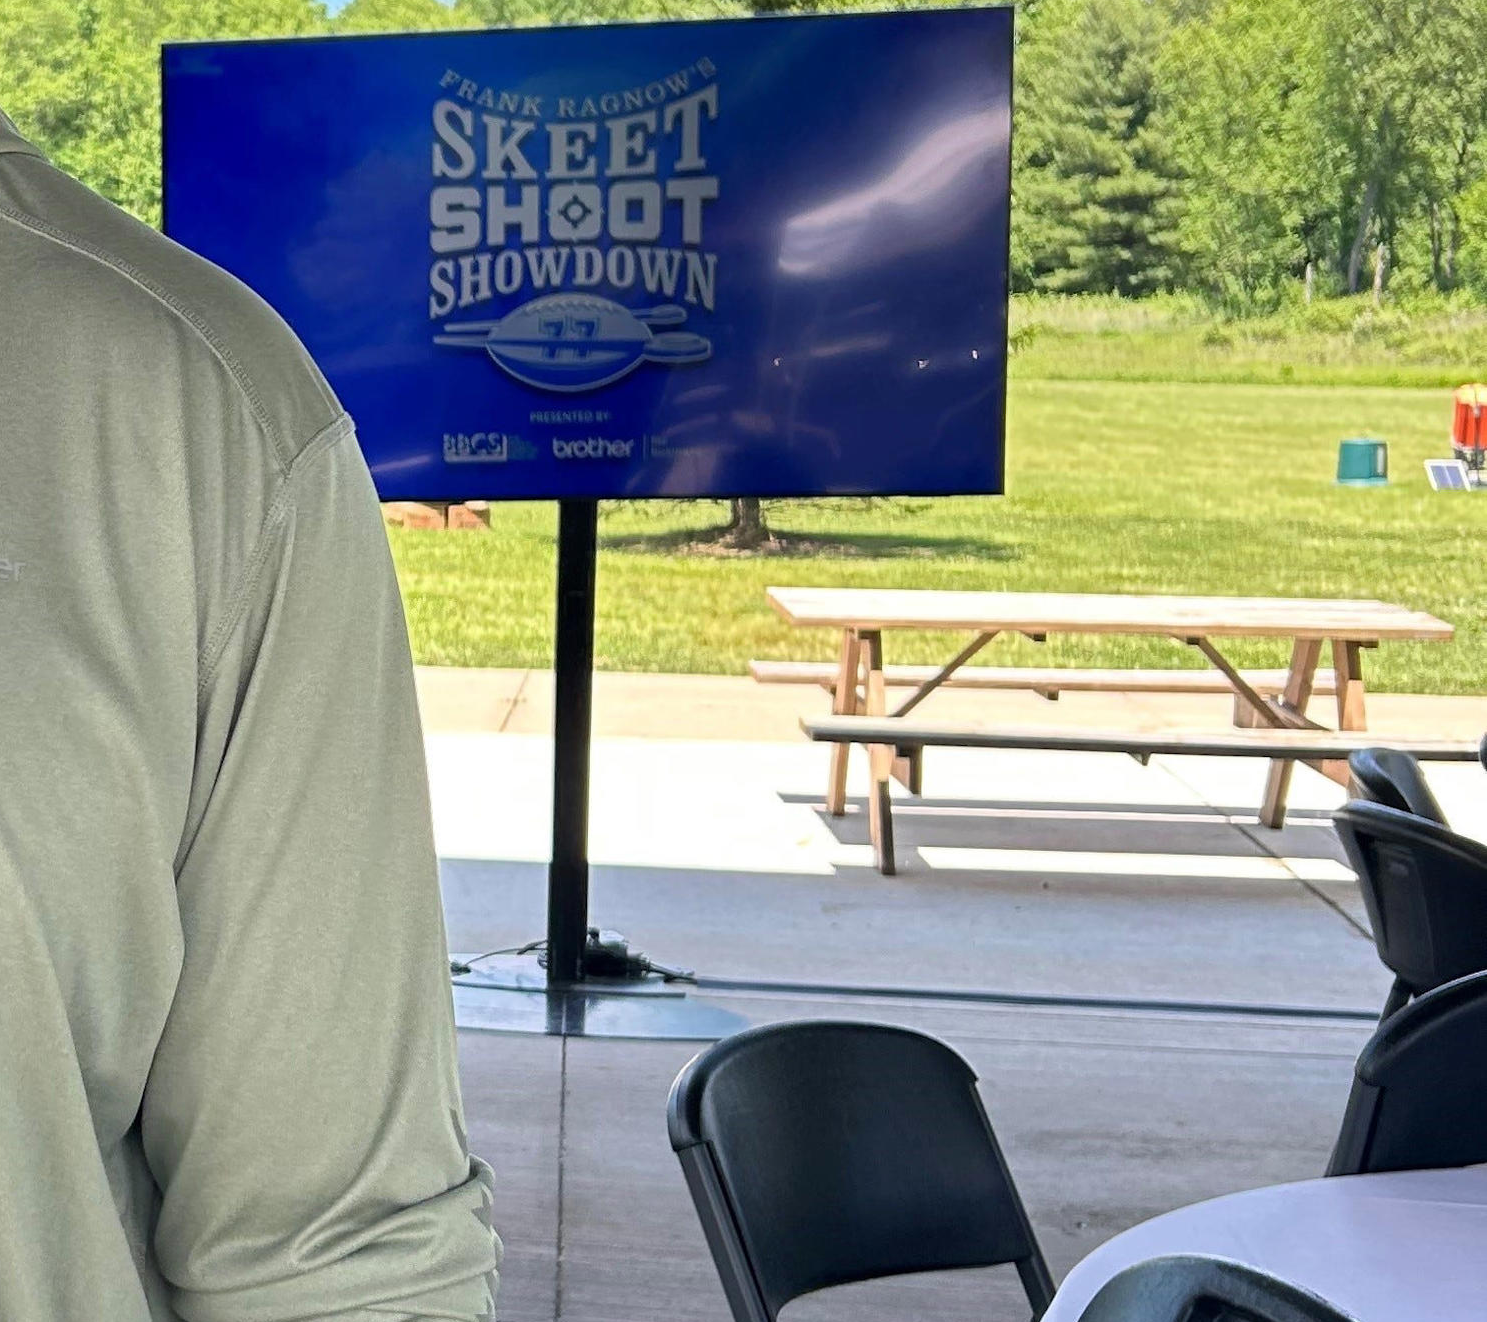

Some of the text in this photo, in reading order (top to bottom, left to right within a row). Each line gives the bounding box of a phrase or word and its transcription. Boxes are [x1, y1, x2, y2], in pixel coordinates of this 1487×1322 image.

[438, 69, 542, 118] FRANK
[432, 82, 719, 180] SKEET
[429, 176, 719, 254] SHOOT
[429, 244, 719, 319] SHOWDOWN
[538, 316, 600, 361] 77
[529, 411, 593, 424] PRESENTED
[552, 435, 634, 460] brother
